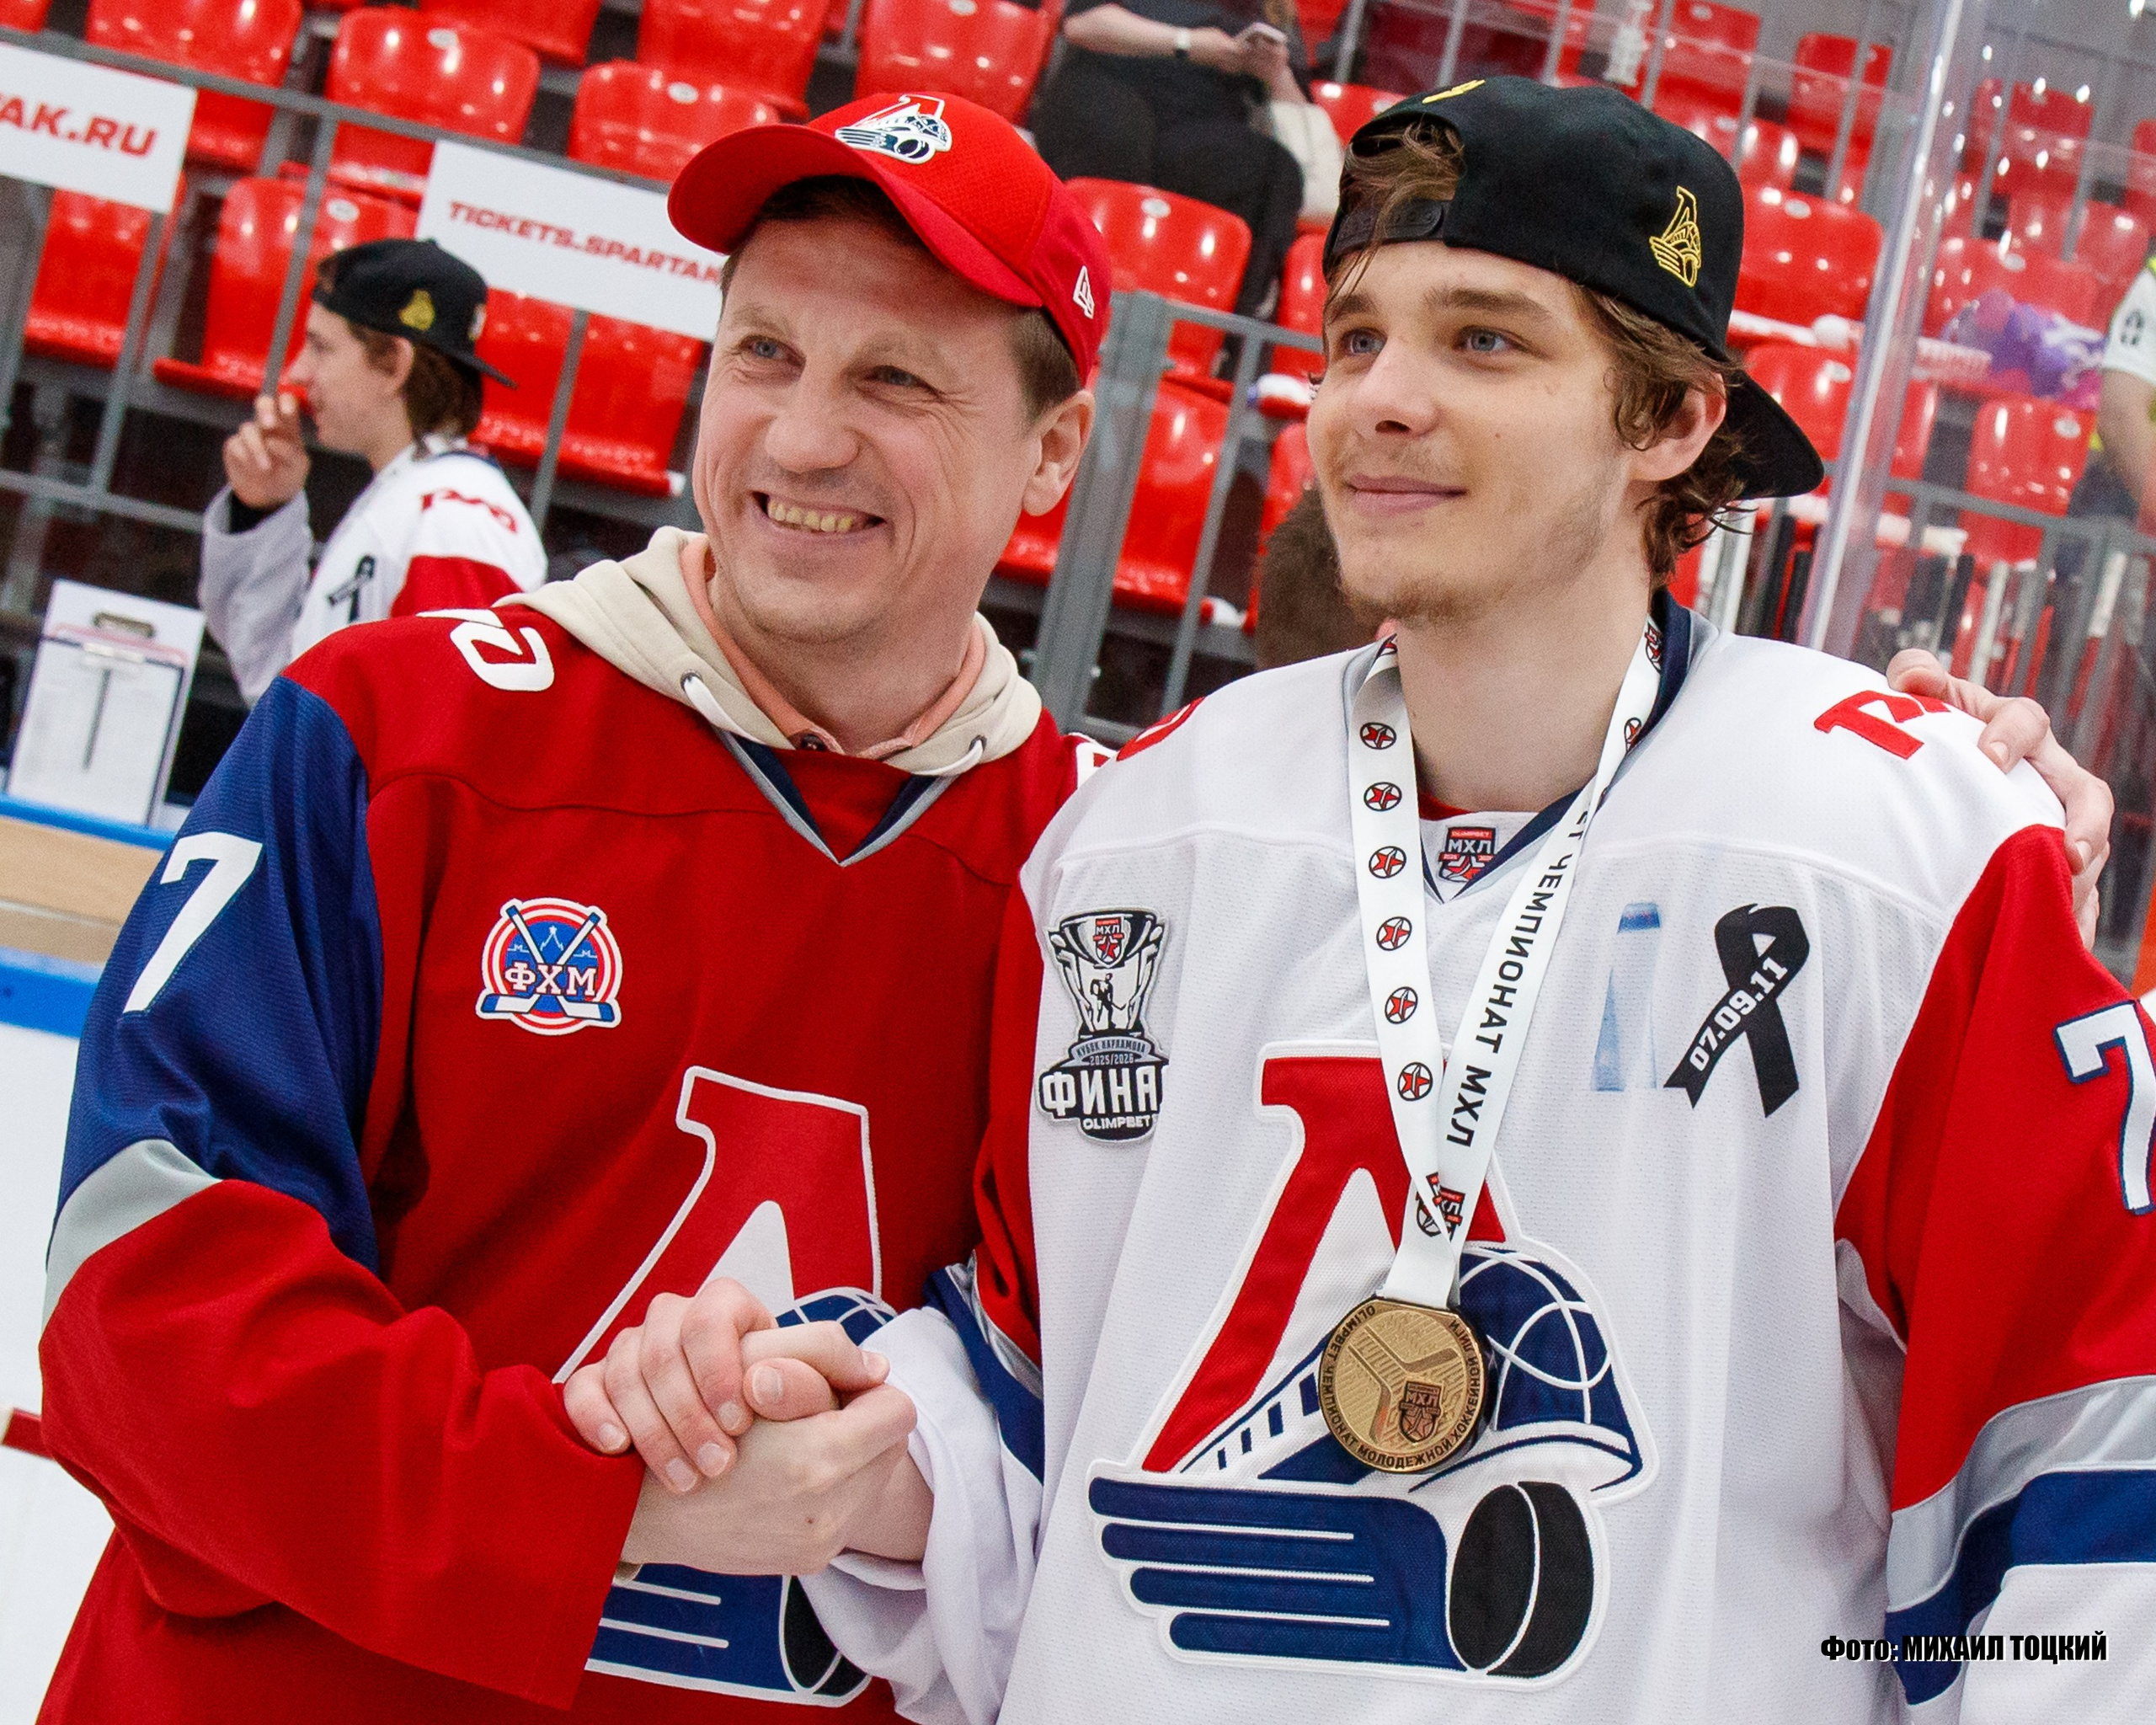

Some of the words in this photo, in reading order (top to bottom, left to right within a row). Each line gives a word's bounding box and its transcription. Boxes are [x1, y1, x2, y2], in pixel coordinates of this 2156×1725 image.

[0, 93, 157, 158] AK.RU
[1448, 839, 1492, 855] МХЛ
[122, 831, 264, 1014] 7
[1096, 925, 1120, 935] МХЛ
[504, 961, 597, 996] ФХМ
[1476, 853, 1573, 1054] ЧЕМПИОНАТ
[1689, 957, 1788, 1071] 07.09.11
[1089, 1053, 1135, 1066] 2025/2026
[1082, 1114, 1152, 1131] OLIMPBET
[1446, 1065, 1492, 1147] МХЛ
[2052, 1000, 2156, 1215] 7
[1328, 1305, 1376, 1362] OLIMPBET
[1449, 1319, 1477, 1354] ЛИГИ
[1321, 1365, 1358, 1448] ЧЕМПИОНАТ
[1406, 1391, 1438, 1407] МХЛ
[1450, 1354, 1481, 1440] ХОККЕЙНОЙ
[1357, 1438, 1453, 1471] МОЛОДЕЖНОЙ
